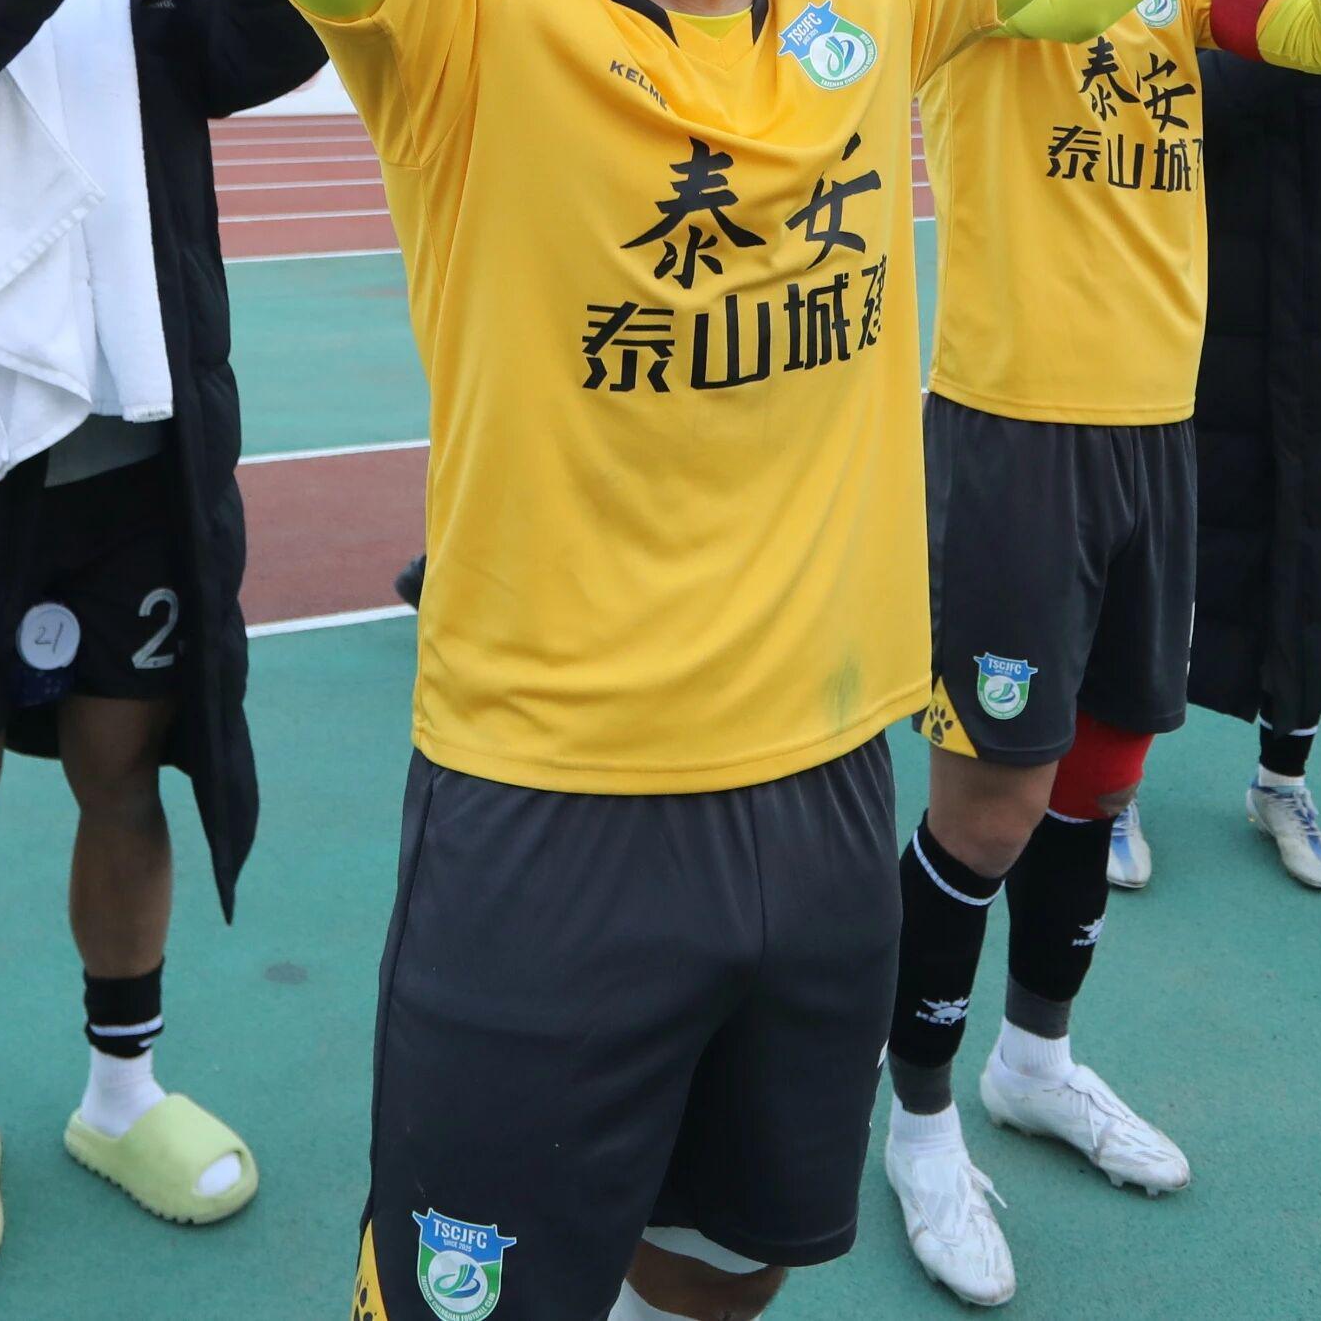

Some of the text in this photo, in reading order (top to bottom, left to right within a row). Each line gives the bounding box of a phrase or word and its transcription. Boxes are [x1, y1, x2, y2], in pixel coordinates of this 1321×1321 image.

[787, 11, 823, 47] TSCJFC
[609, 59, 668, 112] KELME
[1079, 35, 1196, 133] 泰安
[1046, 125, 1204, 192] 泰山城
[622, 134, 882, 290] 泰安
[131, 587, 179, 670] 2
[988, 658, 1022, 675] TSCJFC
[433, 1219, 488, 1250] TSCJFC
